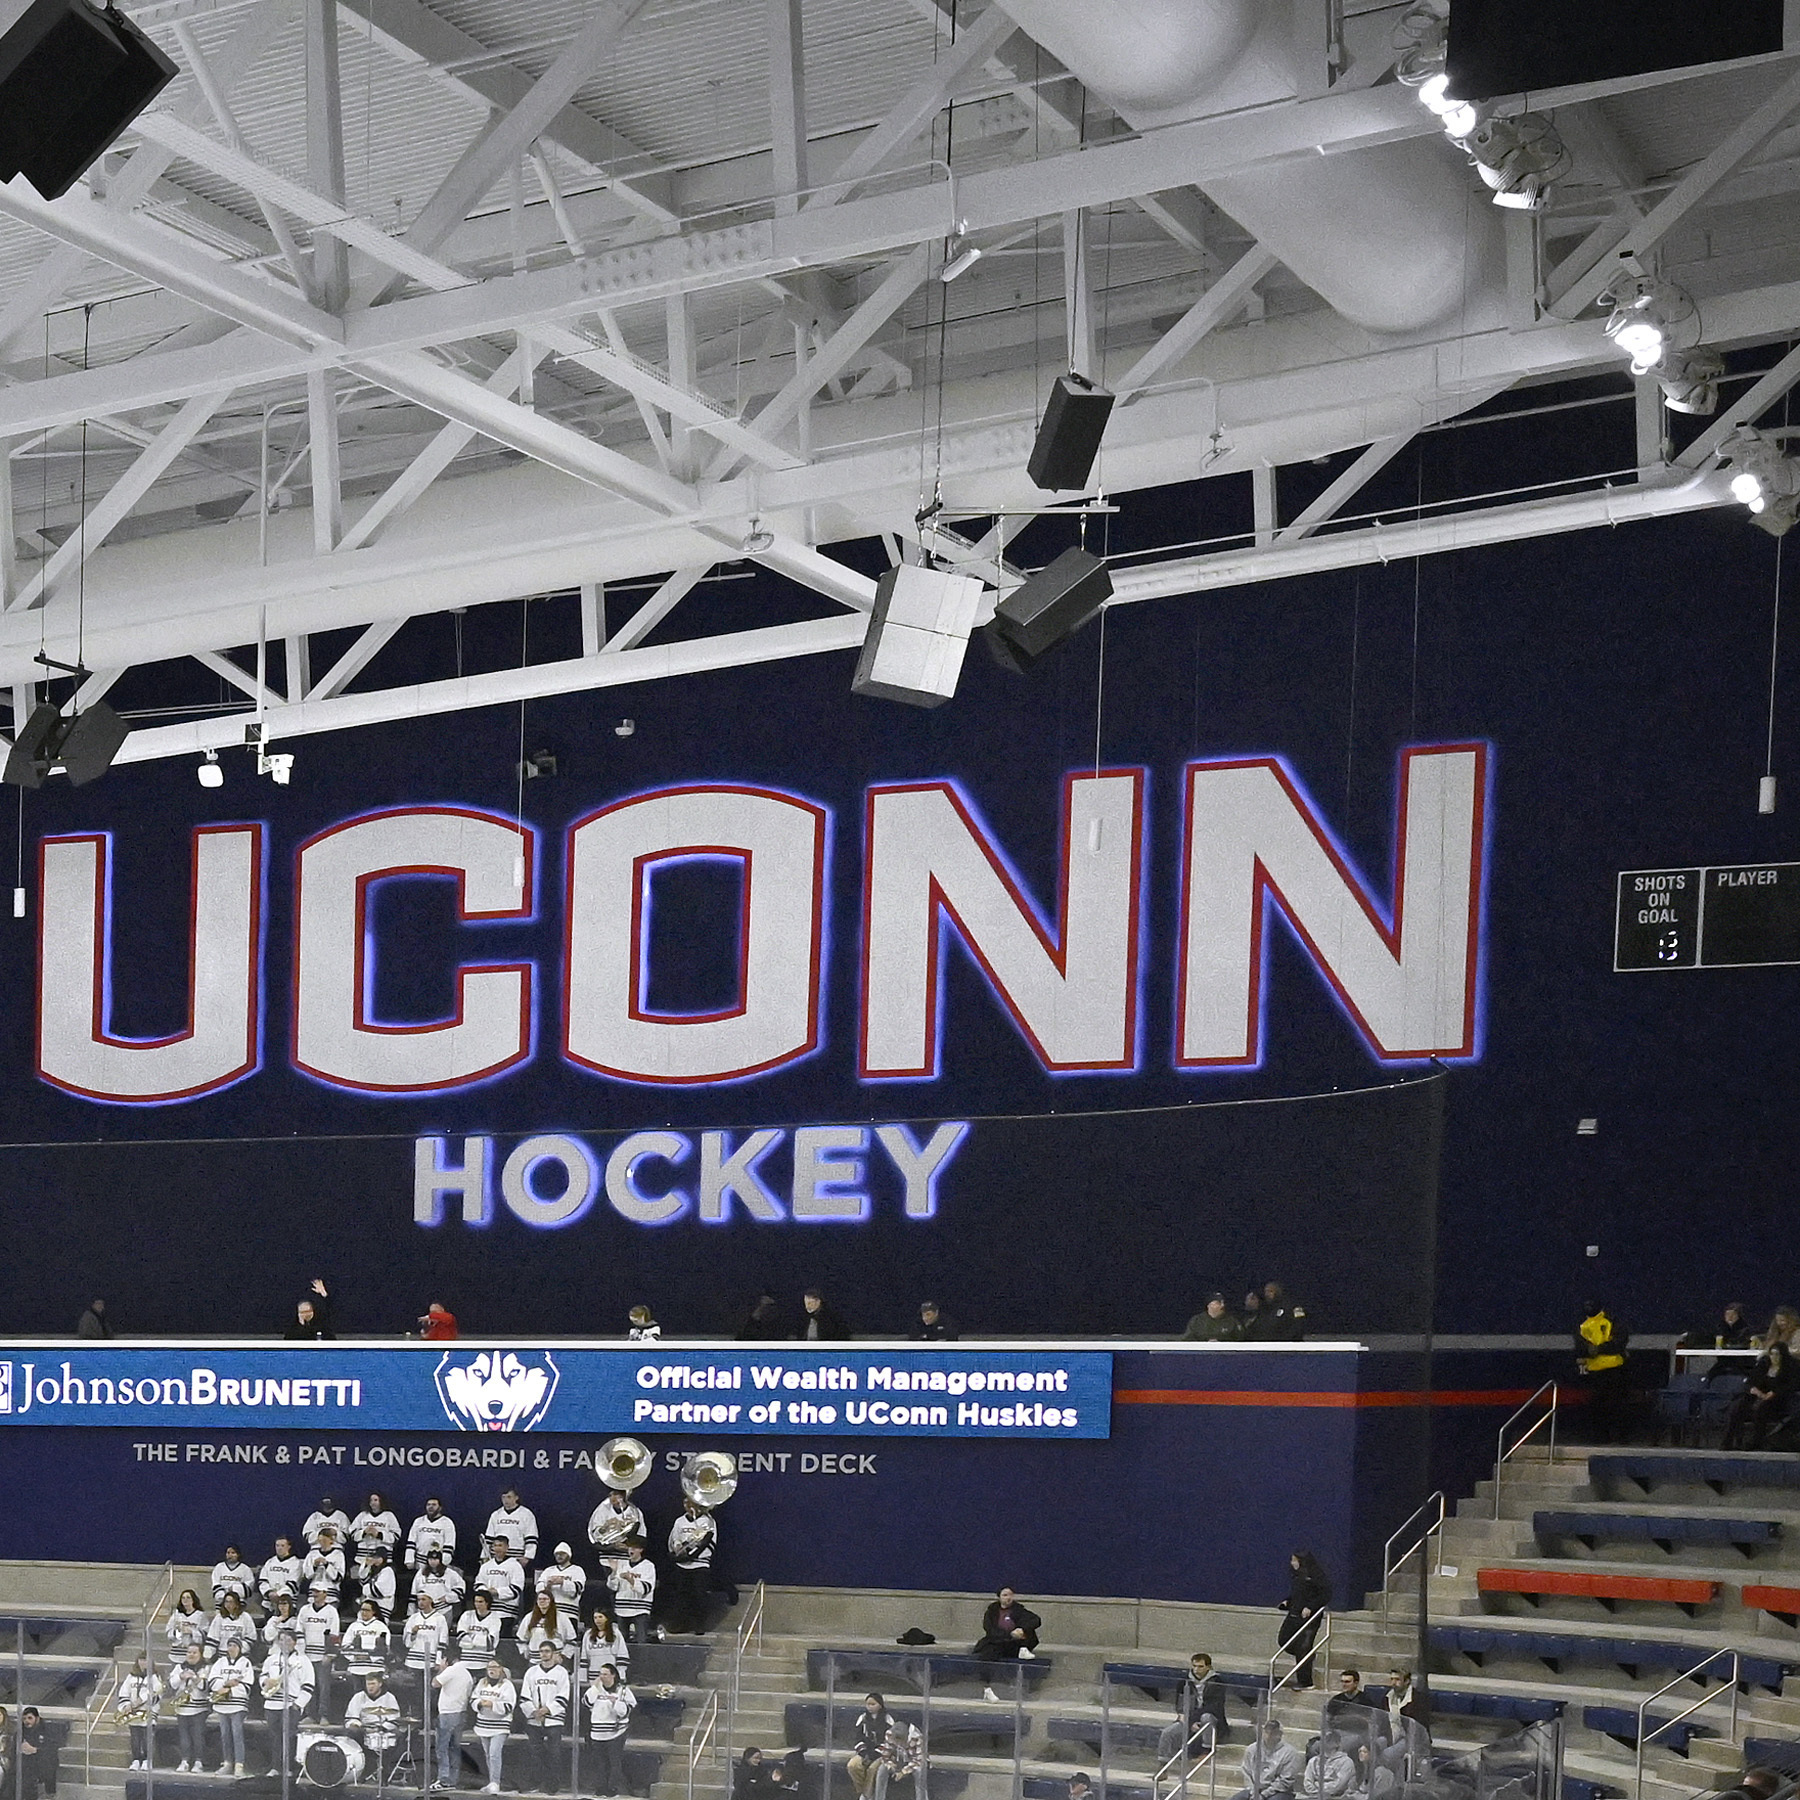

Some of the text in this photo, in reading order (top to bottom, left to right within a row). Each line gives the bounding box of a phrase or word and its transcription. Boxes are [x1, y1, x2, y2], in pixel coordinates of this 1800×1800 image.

[1634, 875, 1686, 892] SHOTS
[1718, 870, 1778, 887] PLAYER
[1648, 893, 1670, 907] ON
[33, 740, 1493, 1103] UCONN
[1638, 909, 1679, 924] GOAL
[412, 1121, 972, 1227] HOCKEY
[635, 1365, 1069, 1396] Official Wealth Management
[633, 1400, 1078, 1428] Partner of the UConn Huskies
[133, 1443, 877, 1475] THE FRANK & PAT LONGOBARDI & DECK
